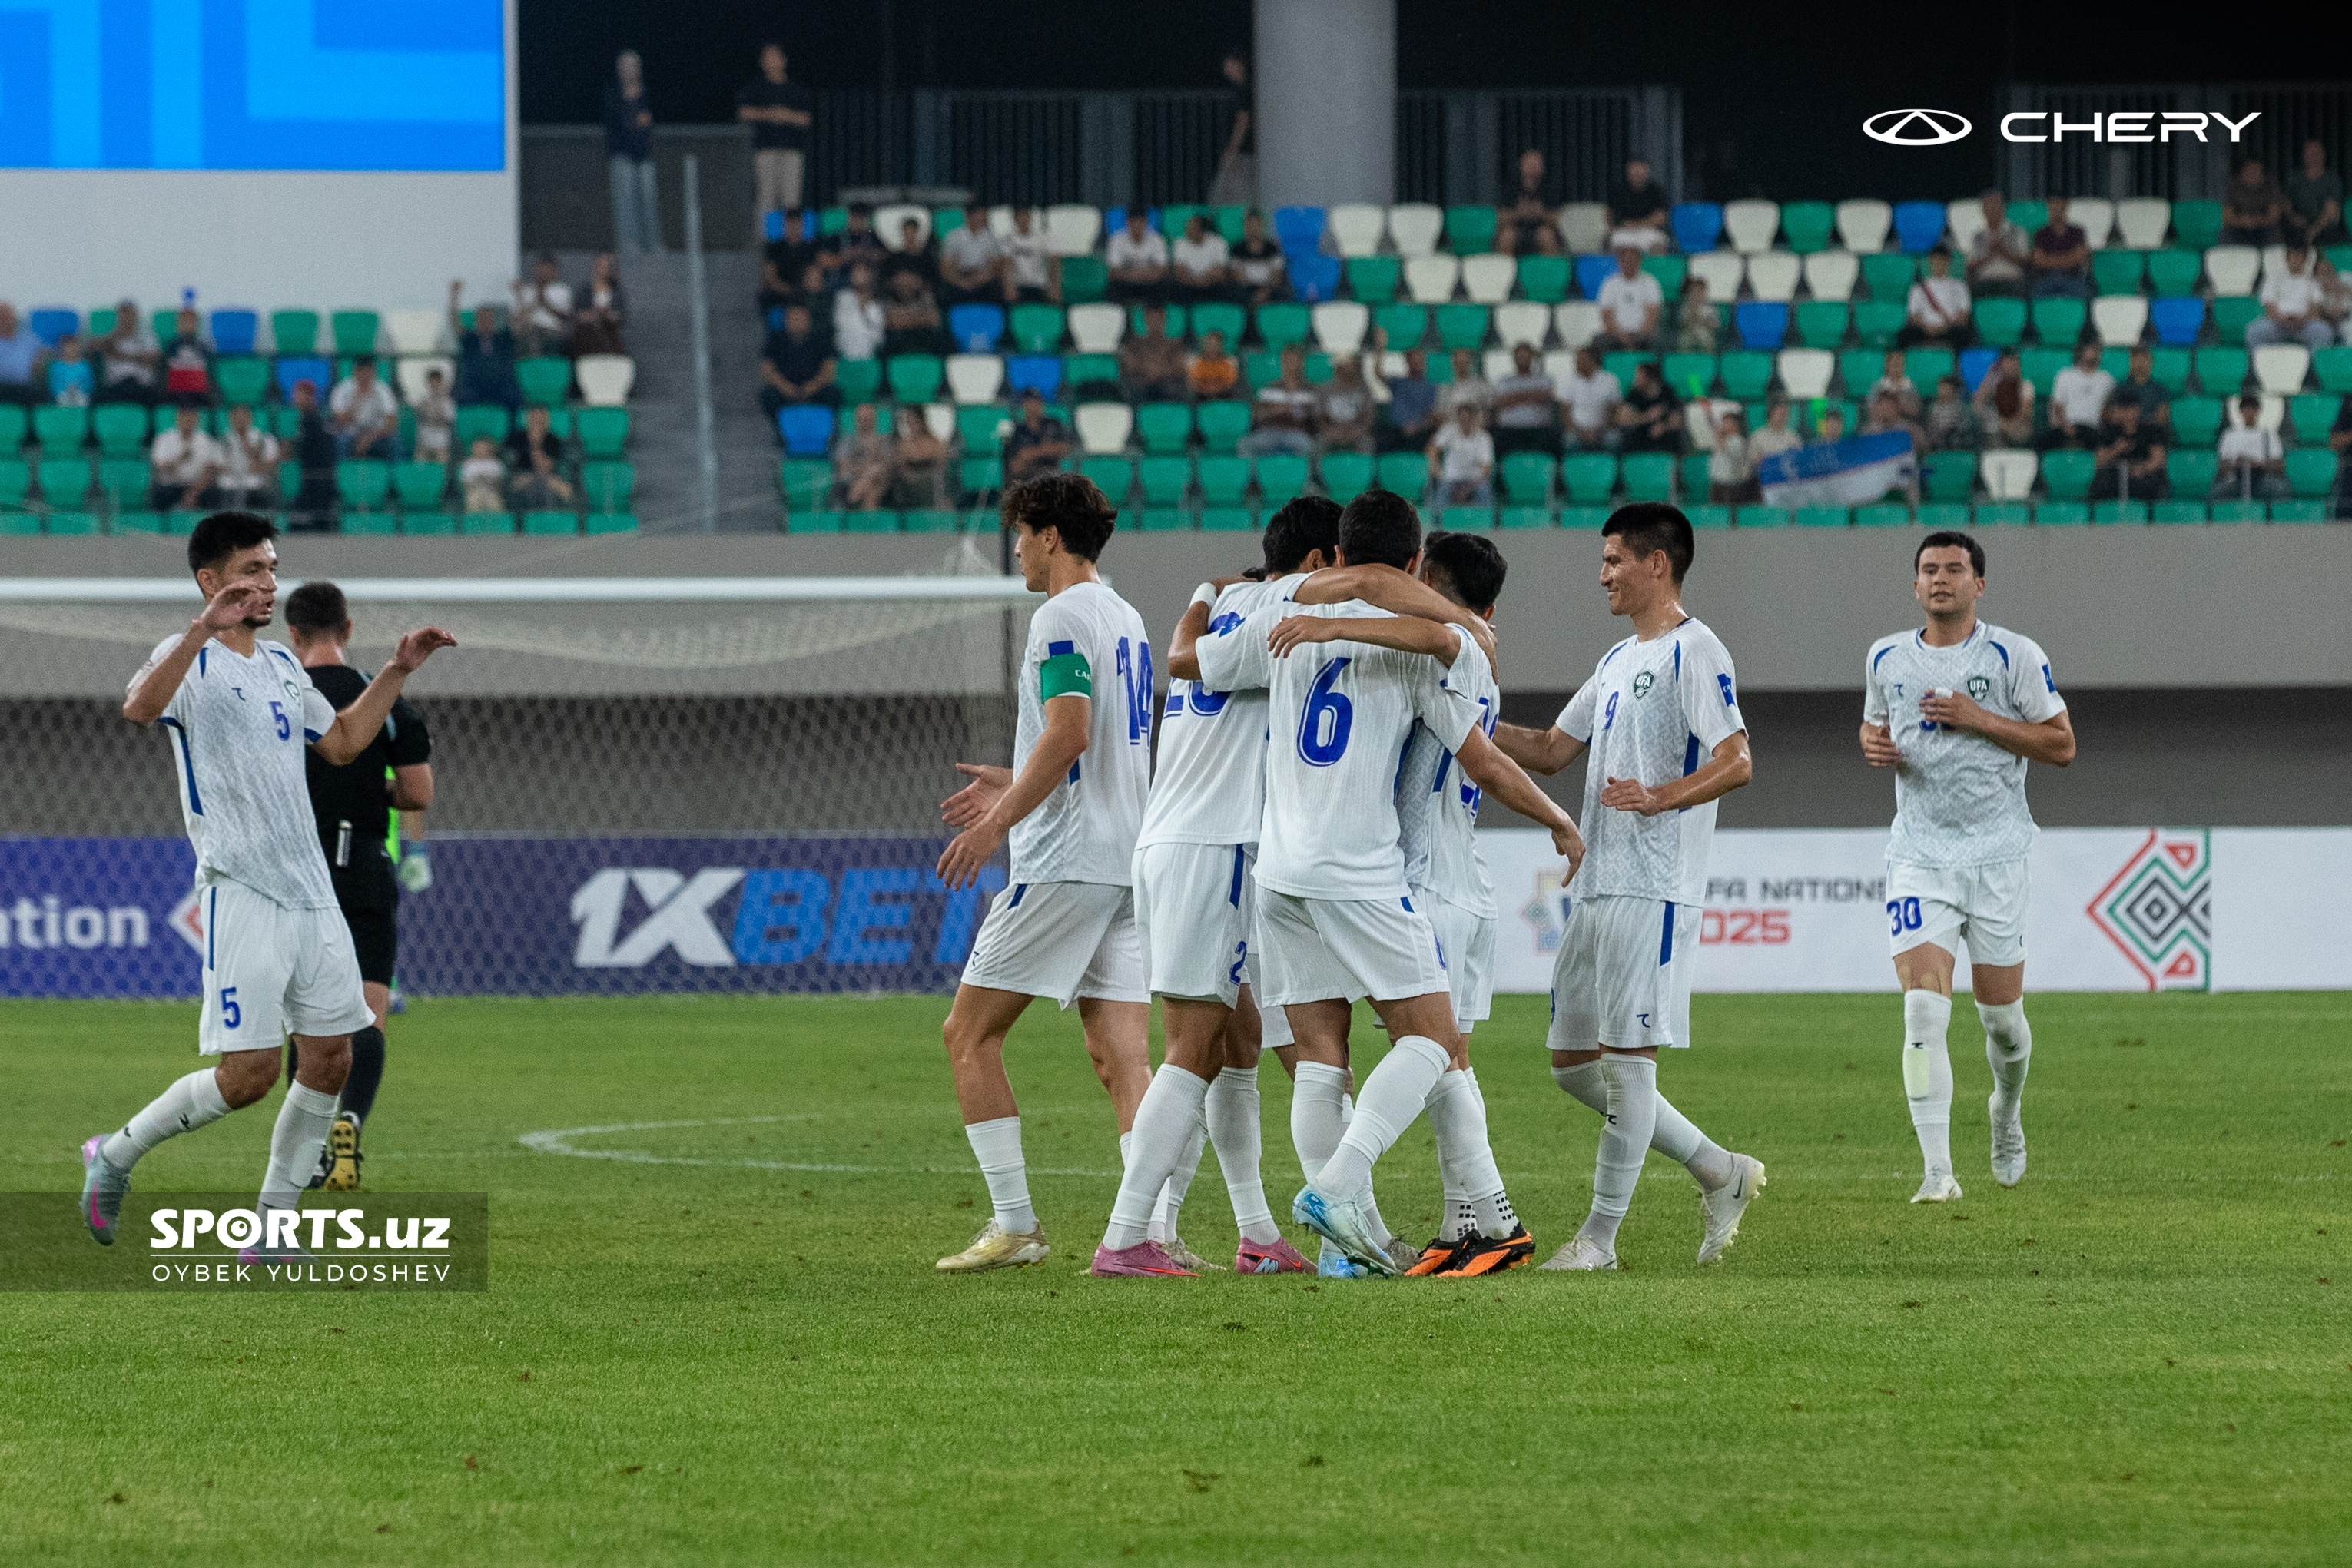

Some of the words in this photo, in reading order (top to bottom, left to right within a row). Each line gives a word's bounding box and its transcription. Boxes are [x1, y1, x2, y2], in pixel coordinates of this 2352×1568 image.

[1116, 636, 1153, 752] 14
[1637, 674, 1651, 688] UFA
[1969, 678, 1989, 691] UFA
[269, 701, 290, 742] 5
[1297, 657, 1353, 767] 6
[1603, 691, 1619, 731] 9
[571, 867, 1007, 968] 1XBET
[1699, 909, 1792, 945] 025
[1886, 896, 1922, 936] 30
[221, 986, 241, 1029] 5
